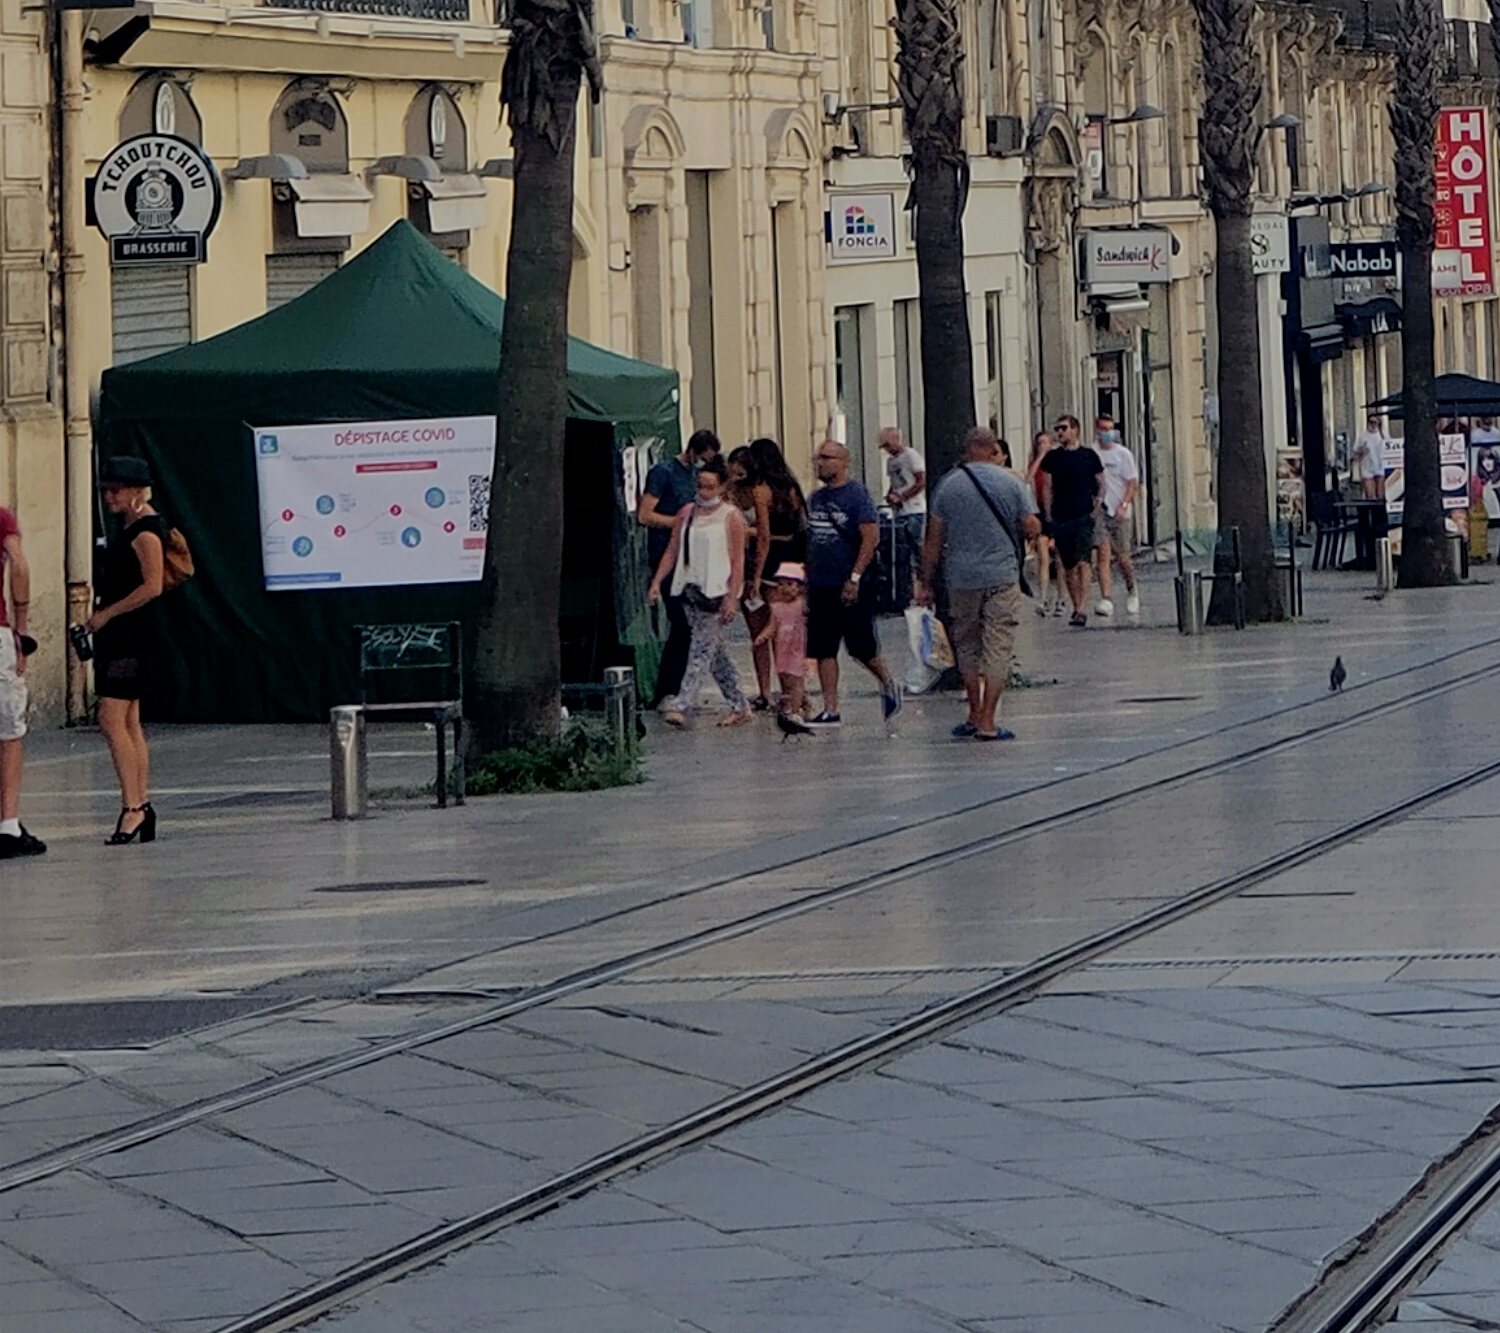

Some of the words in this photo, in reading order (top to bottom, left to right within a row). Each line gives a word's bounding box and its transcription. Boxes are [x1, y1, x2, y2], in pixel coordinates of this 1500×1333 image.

[102, 142, 207, 192] TCHOUTCHOU
[1450, 112, 1486, 282] HÔTEL
[122, 241, 188, 255] BRASSERIE
[838, 237, 888, 247] FONCIA
[1331, 248, 1393, 272] Nabab
[334, 430, 409, 446] DÉPISTAGE
[413, 428, 456, 442] COVID
